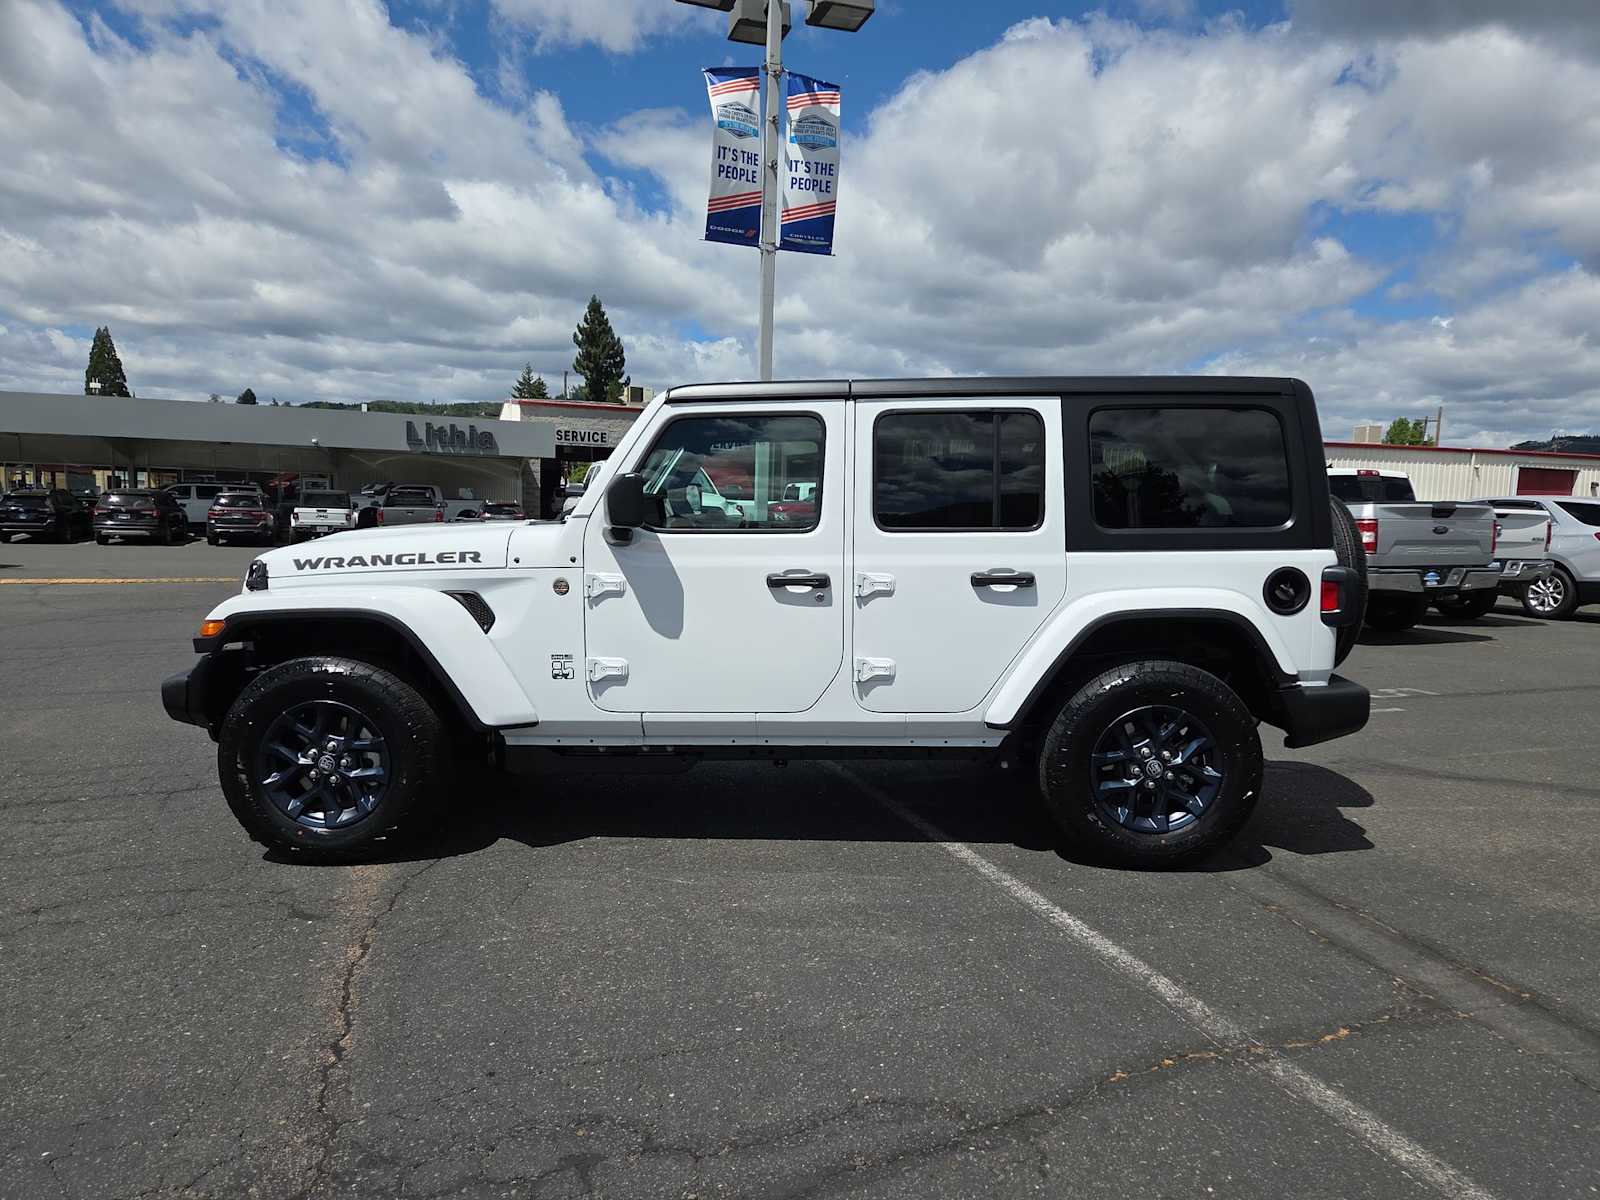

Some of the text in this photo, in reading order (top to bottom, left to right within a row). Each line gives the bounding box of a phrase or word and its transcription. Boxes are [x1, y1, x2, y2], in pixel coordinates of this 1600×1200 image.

[717, 145, 759, 166] IT'S THE
[718, 164, 757, 184] PEOPLE
[789, 159, 834, 176] IT'S THE
[790, 176, 831, 193] PEOPLE
[709, 225, 745, 234] DODGE
[406, 421, 498, 449] Lithia
[556, 429, 607, 443] SERVICE
[293, 551, 482, 571] WRANGLER
